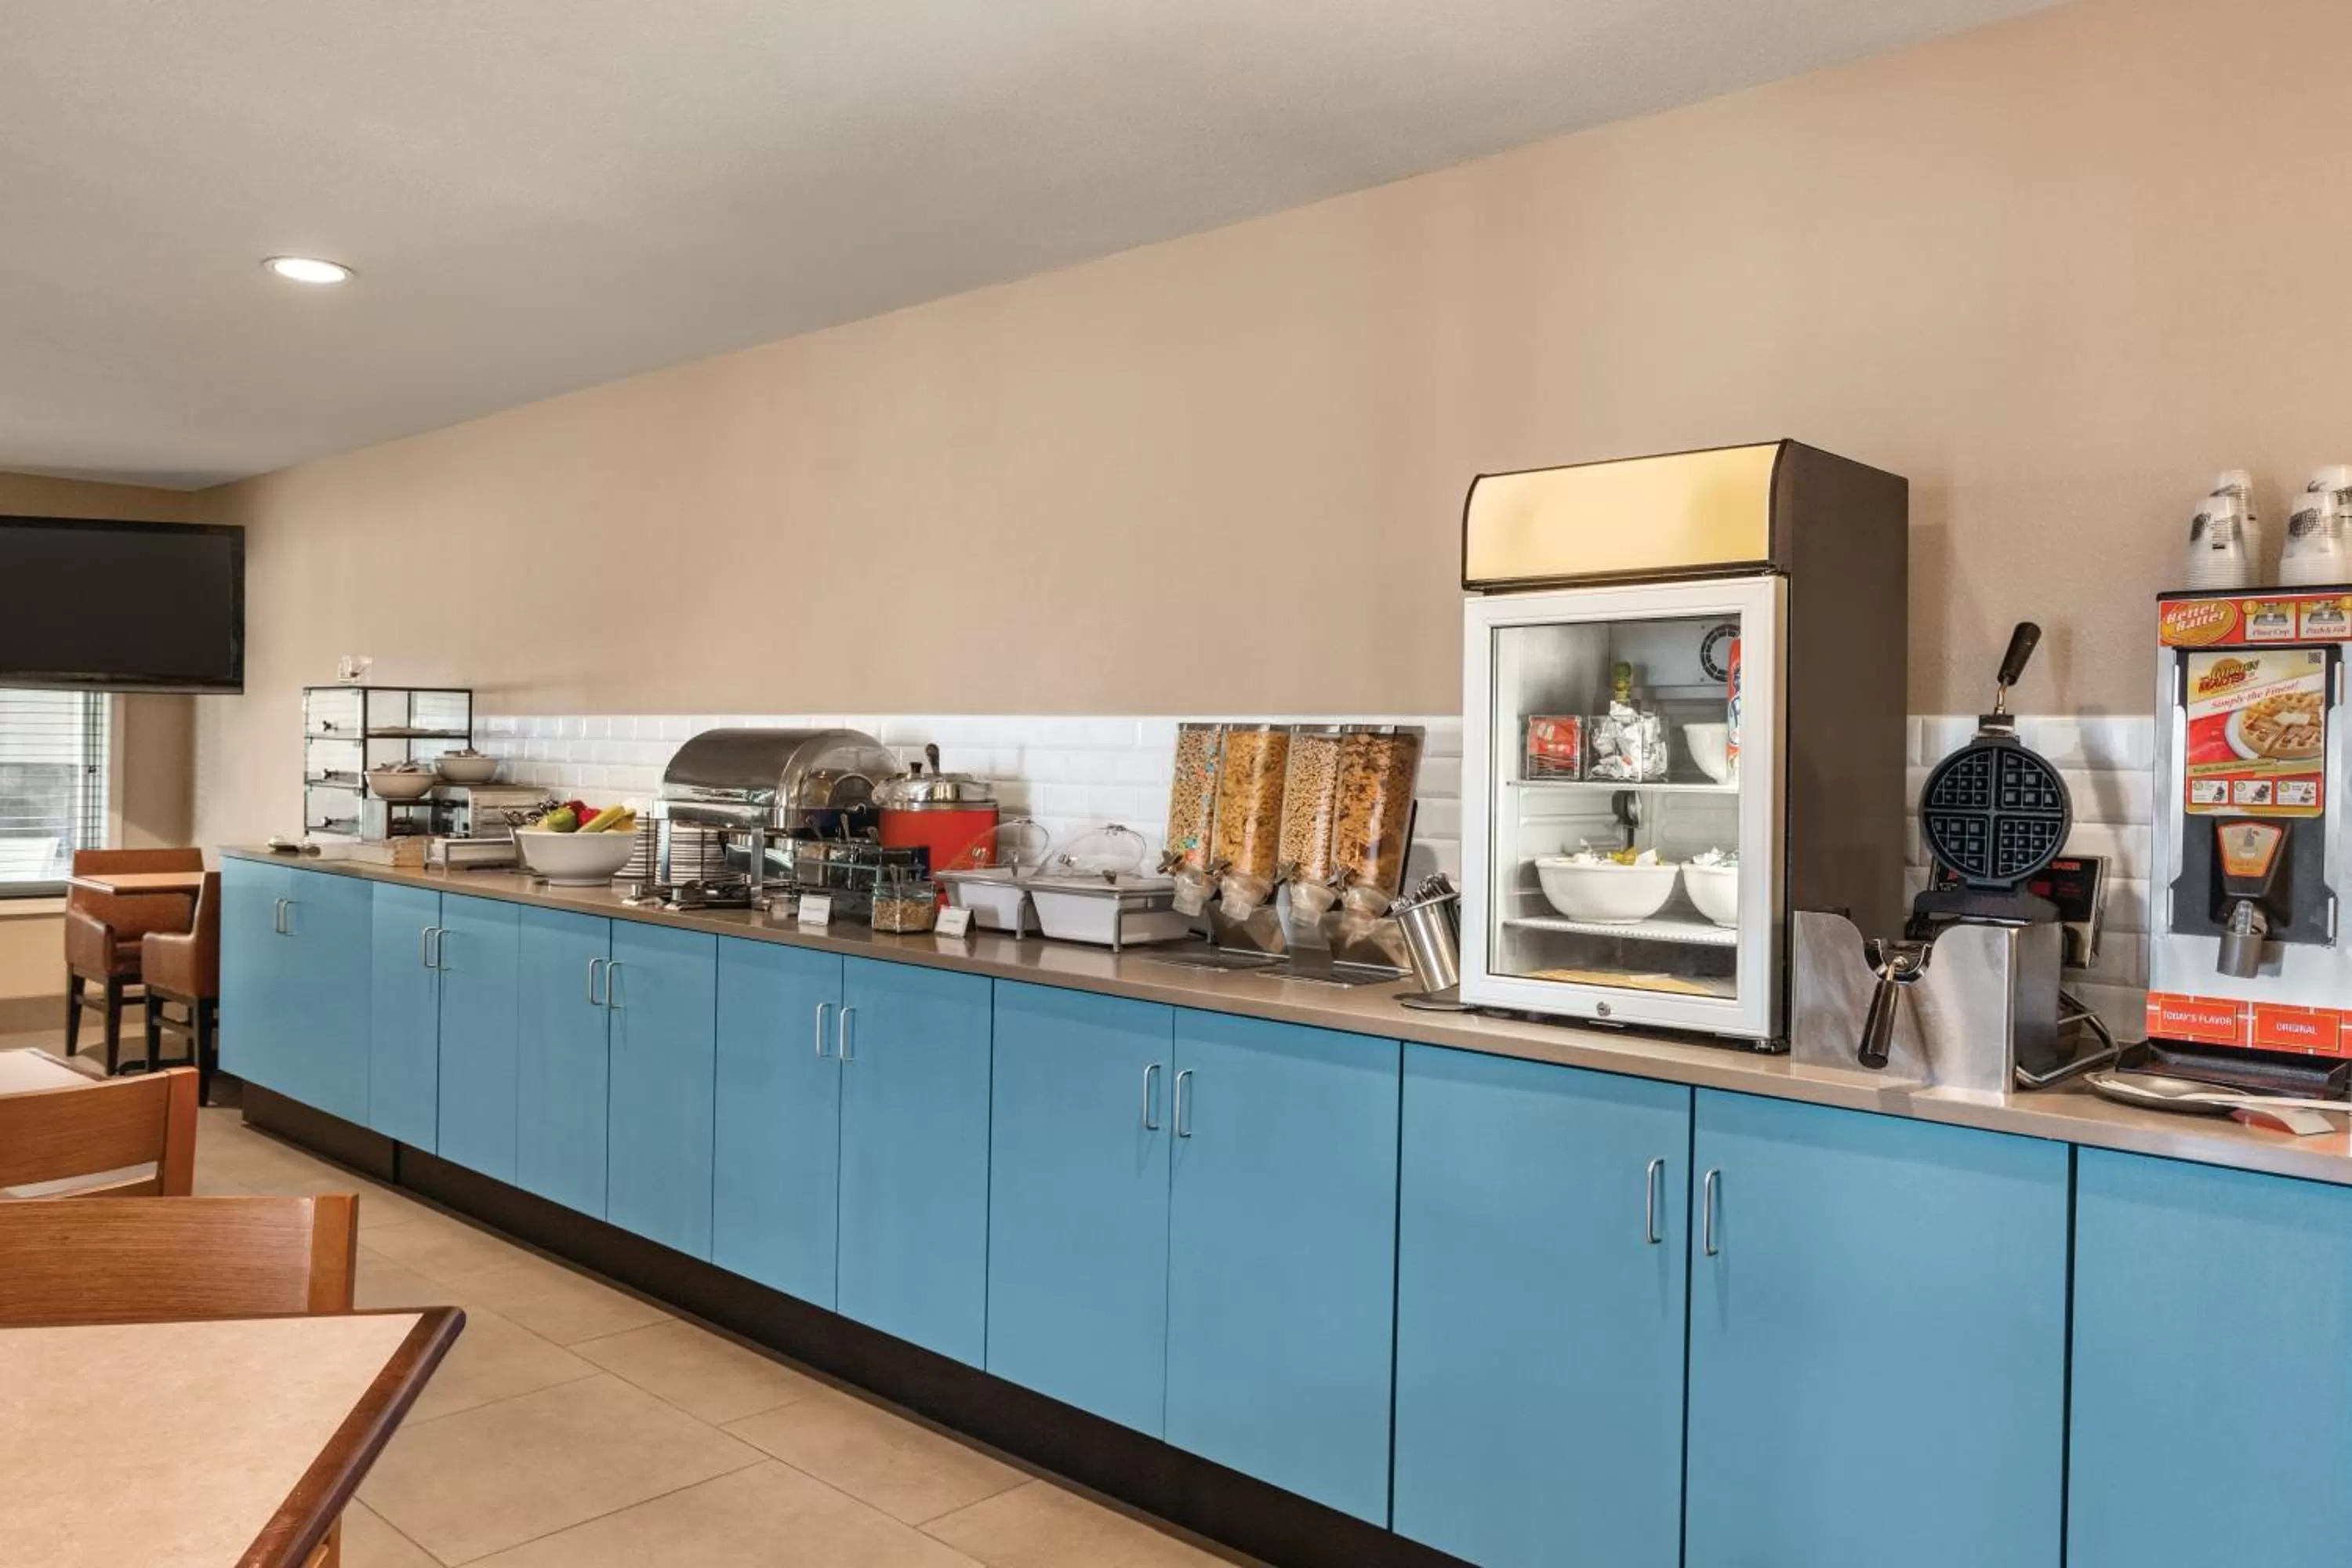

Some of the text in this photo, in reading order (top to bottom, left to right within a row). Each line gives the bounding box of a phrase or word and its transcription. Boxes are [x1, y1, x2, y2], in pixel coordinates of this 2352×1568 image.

[2166, 603, 2217, 625] Better
[2176, 611, 2227, 631] Batter
[2162, 1010, 2233, 1026] TODAY'S FLAVOR
[2276, 1022, 2316, 1034] ORIGINAL
